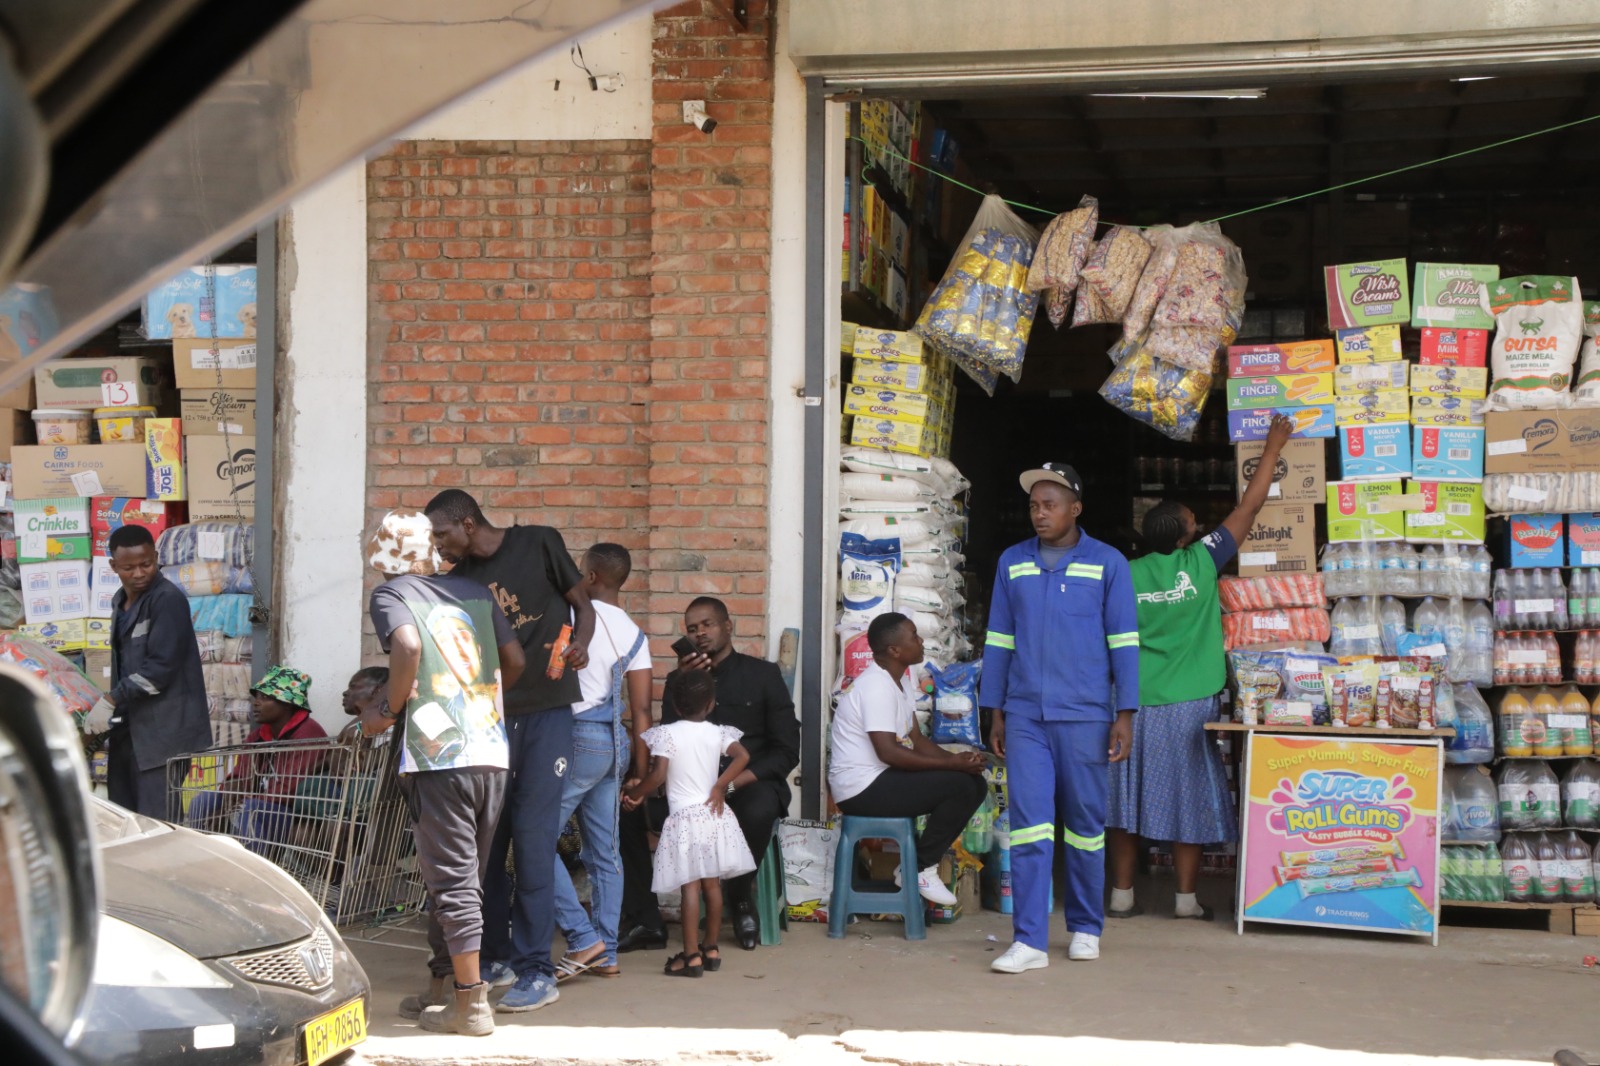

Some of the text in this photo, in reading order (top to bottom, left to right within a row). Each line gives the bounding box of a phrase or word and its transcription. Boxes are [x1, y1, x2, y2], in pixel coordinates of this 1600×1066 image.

[1360, 275, 1397, 291] Wish
[1352, 289, 1400, 304] Creams
[1437, 291, 1480, 306] Cream
[1345, 340, 1369, 352] JOE
[1437, 345, 1458, 353] Milk
[1504, 336, 1557, 352] GUTSA
[1241, 353, 1281, 365] FINGER
[1505, 353, 1531, 361] MAIZE
[106, 382, 129, 406] 13
[1239, 385, 1278, 396] FINGER
[869, 405, 898, 415] COOKIES
[1367, 427, 1401, 435] VANILLA
[1443, 431, 1477, 439] VANILLA
[43, 460, 104, 469] CAIRNS FOODS
[216, 460, 256, 480] Cremor
[160, 467, 172, 494] JOE
[96, 509, 121, 520] Softy
[27, 515, 79, 532] Crinkles
[1247, 525, 1293, 542] Sunlight
[1516, 528, 1559, 539] Revive
[96, 540, 110, 548] Sof
[1346, 685, 1373, 698] ffee
[1267, 754, 1305, 771] Super
[1361, 750, 1401, 767] Super
[1402, 760, 1429, 779] Fun!
[1298, 772, 1389, 802] SUPER
[1286, 805, 1337, 832] ROLL
[1307, 830, 1389, 841] TASTY BUBBLE GUMS
[310, 1007, 362, 1062] AFH 9856
